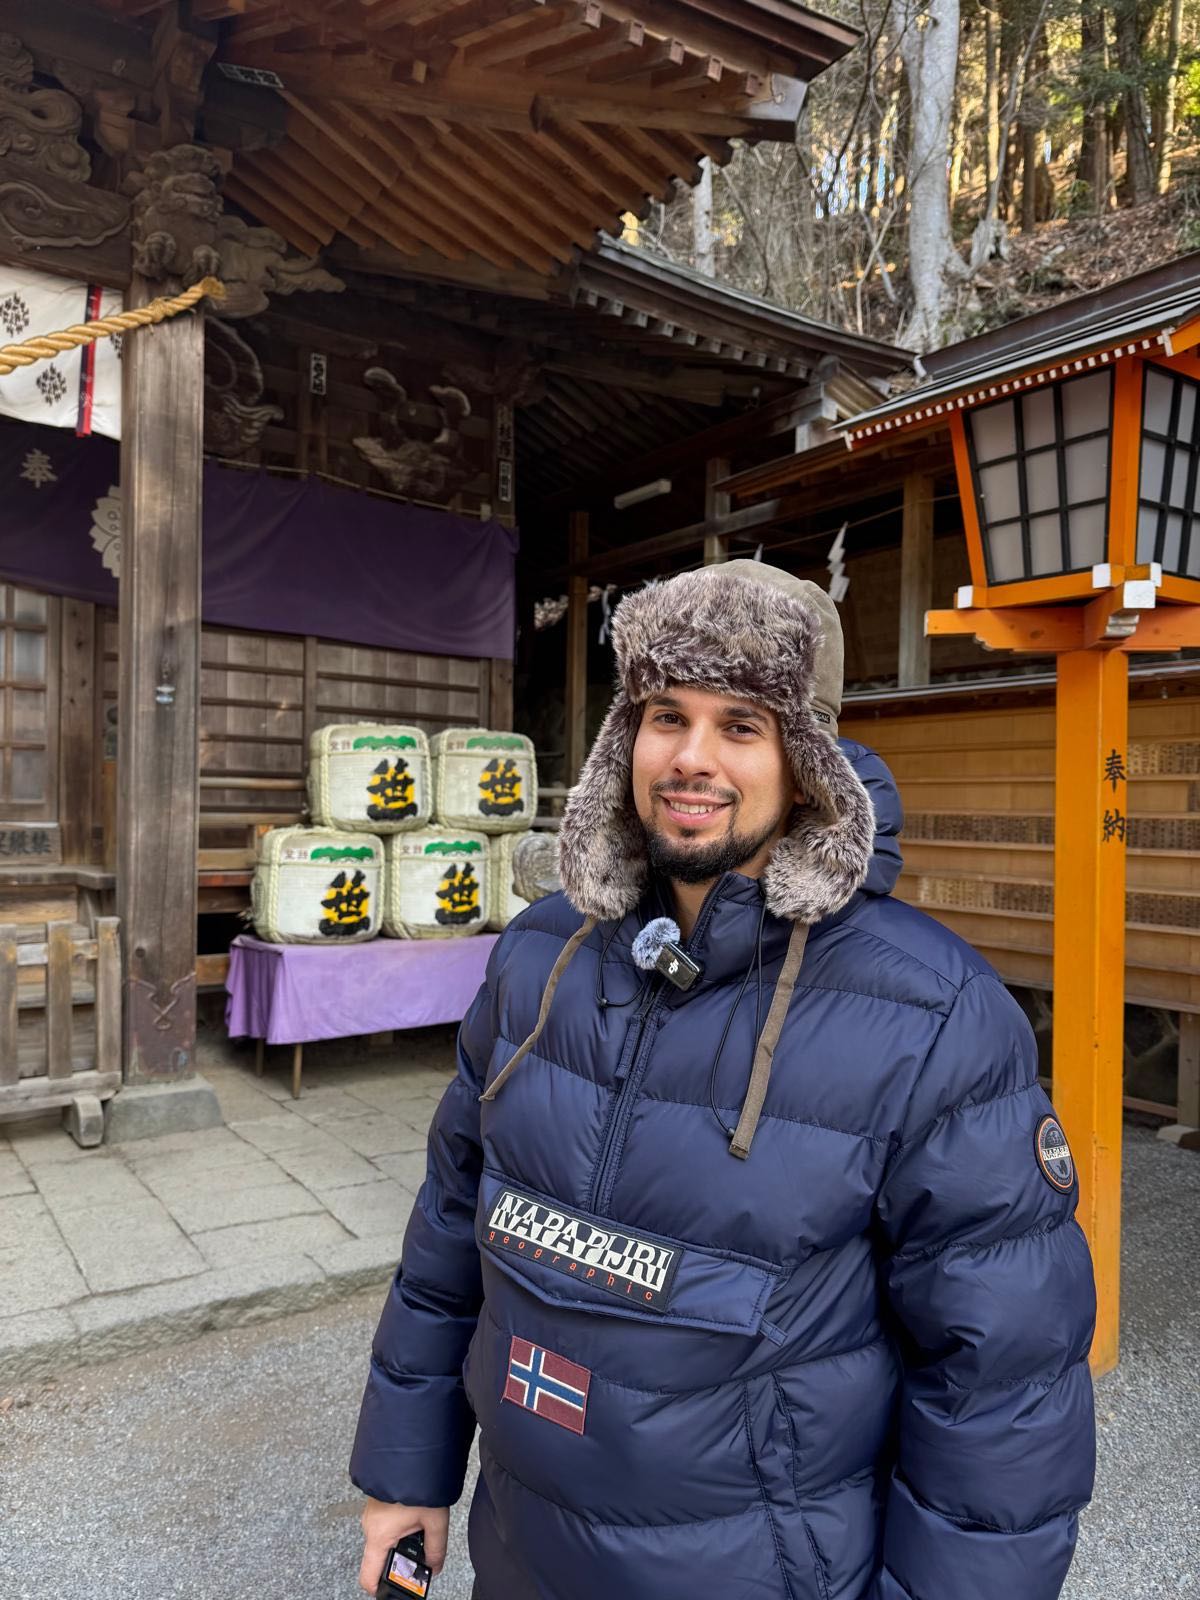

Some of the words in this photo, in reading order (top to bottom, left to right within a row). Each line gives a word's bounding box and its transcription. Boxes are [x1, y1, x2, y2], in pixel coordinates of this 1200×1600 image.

[20, 448, 57, 488] 奉
[1102, 748, 1126, 843] 奉納
[488, 1230, 653, 1301] geographic
[491, 1194, 669, 1287] NAPAPIJRI
